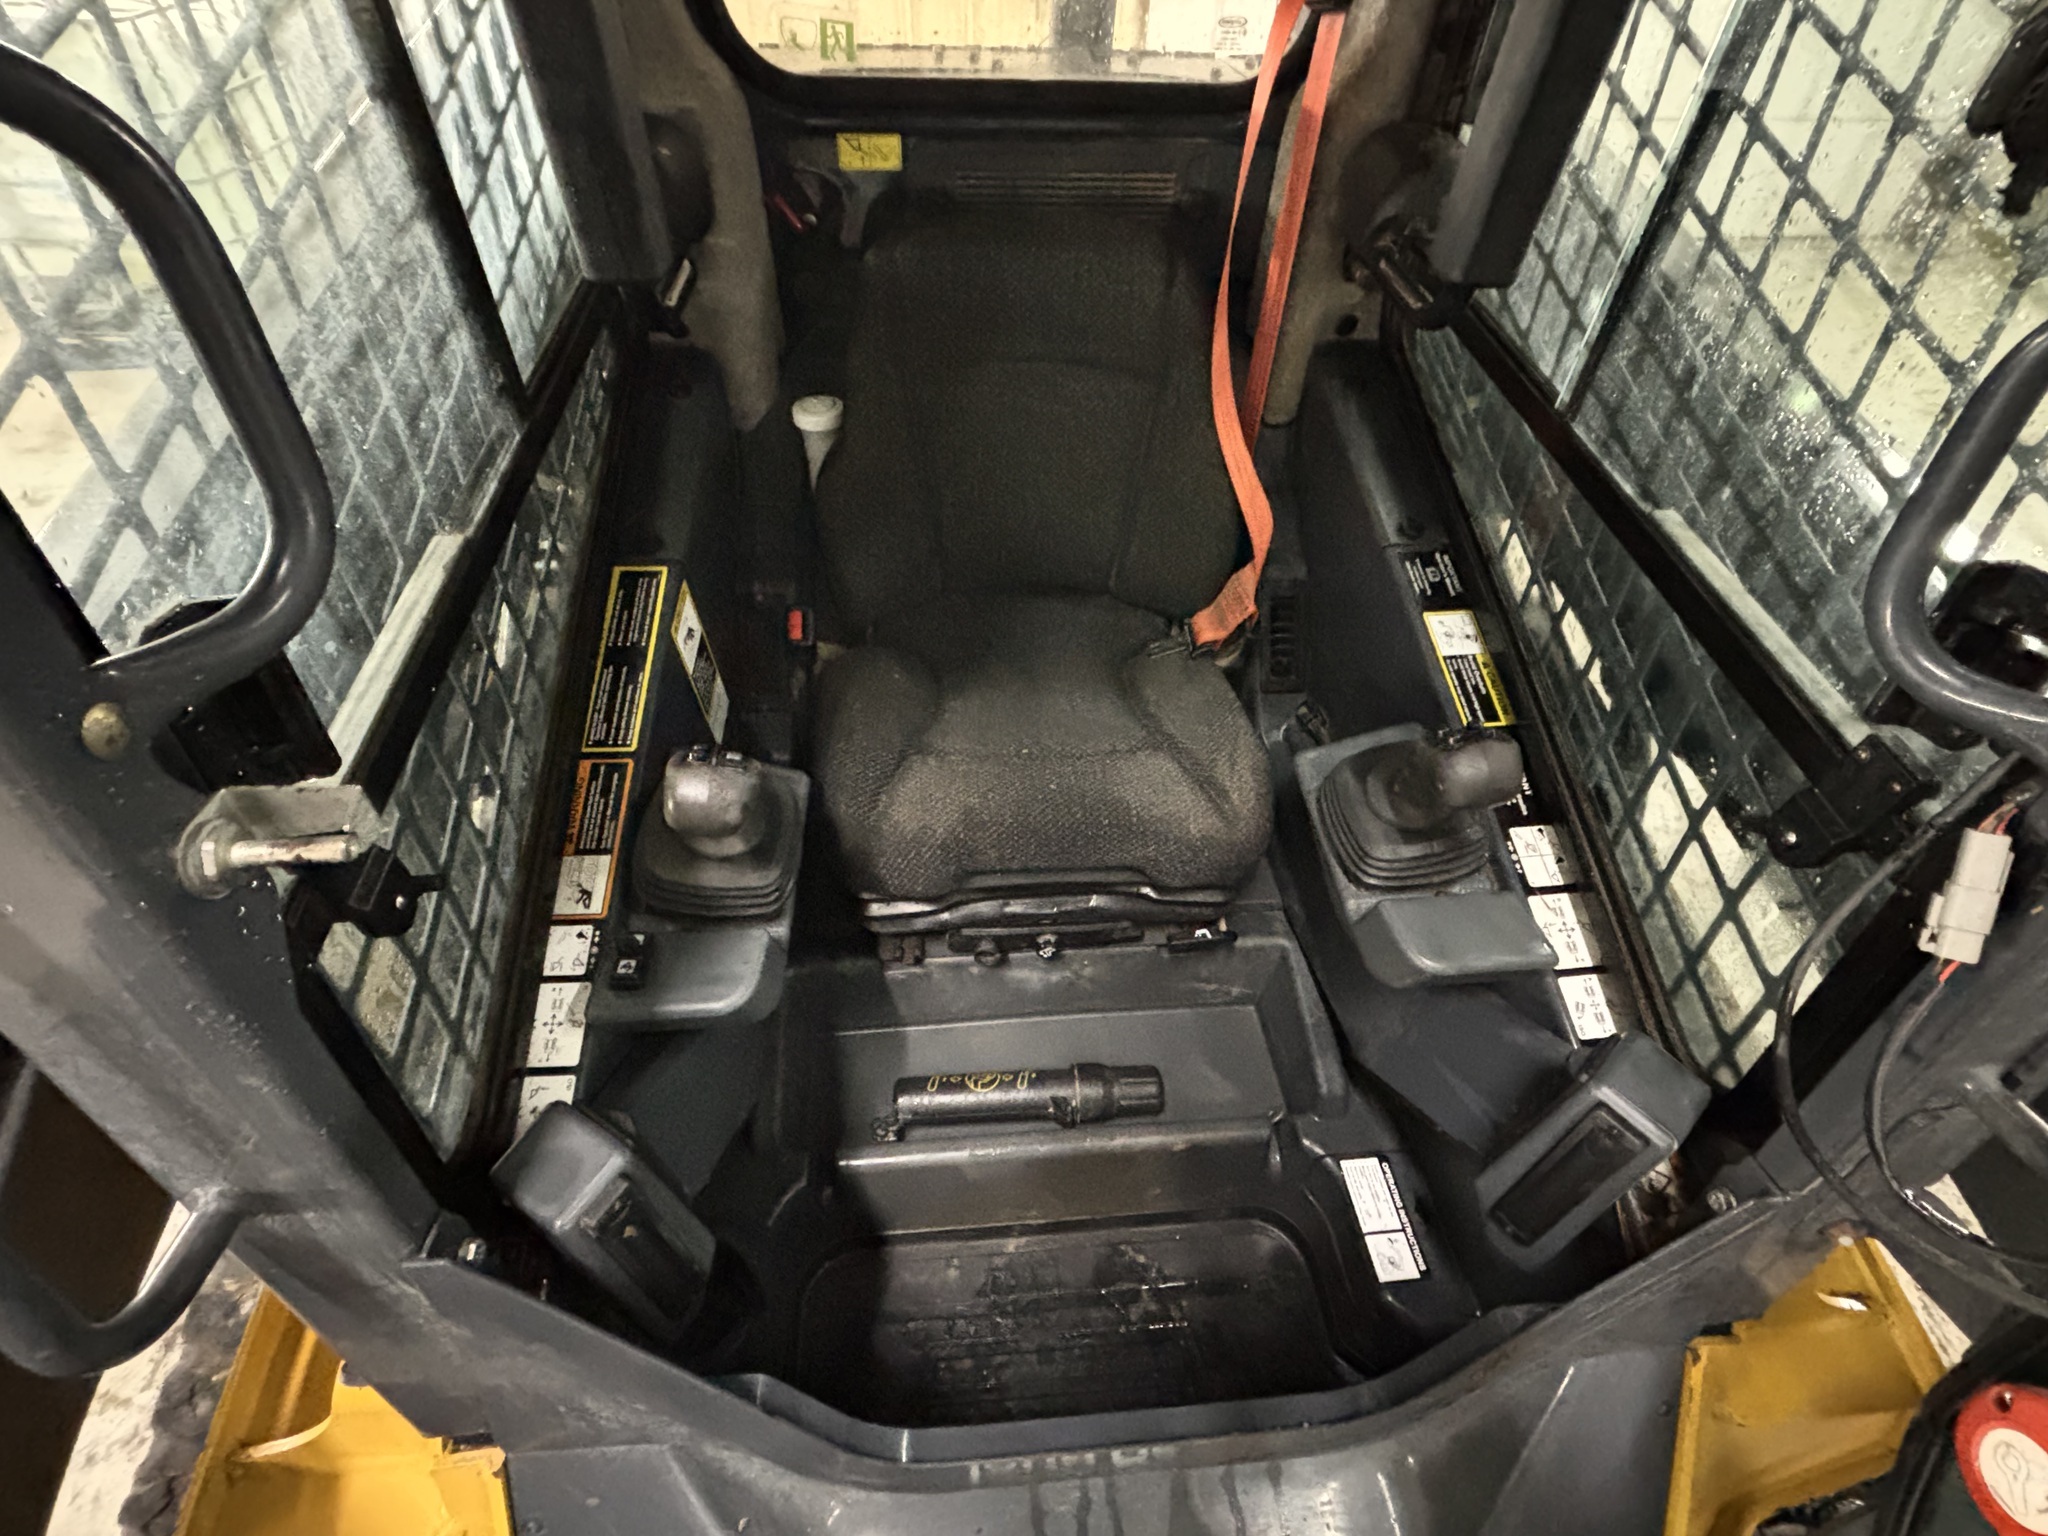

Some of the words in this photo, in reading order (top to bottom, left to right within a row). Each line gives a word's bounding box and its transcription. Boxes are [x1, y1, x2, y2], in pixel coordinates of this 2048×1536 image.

[568, 777, 584, 829] WARNING
[1381, 1162, 1403, 1209] OPERATING
[1398, 1208, 1427, 1272] INSTRUCTIONS
